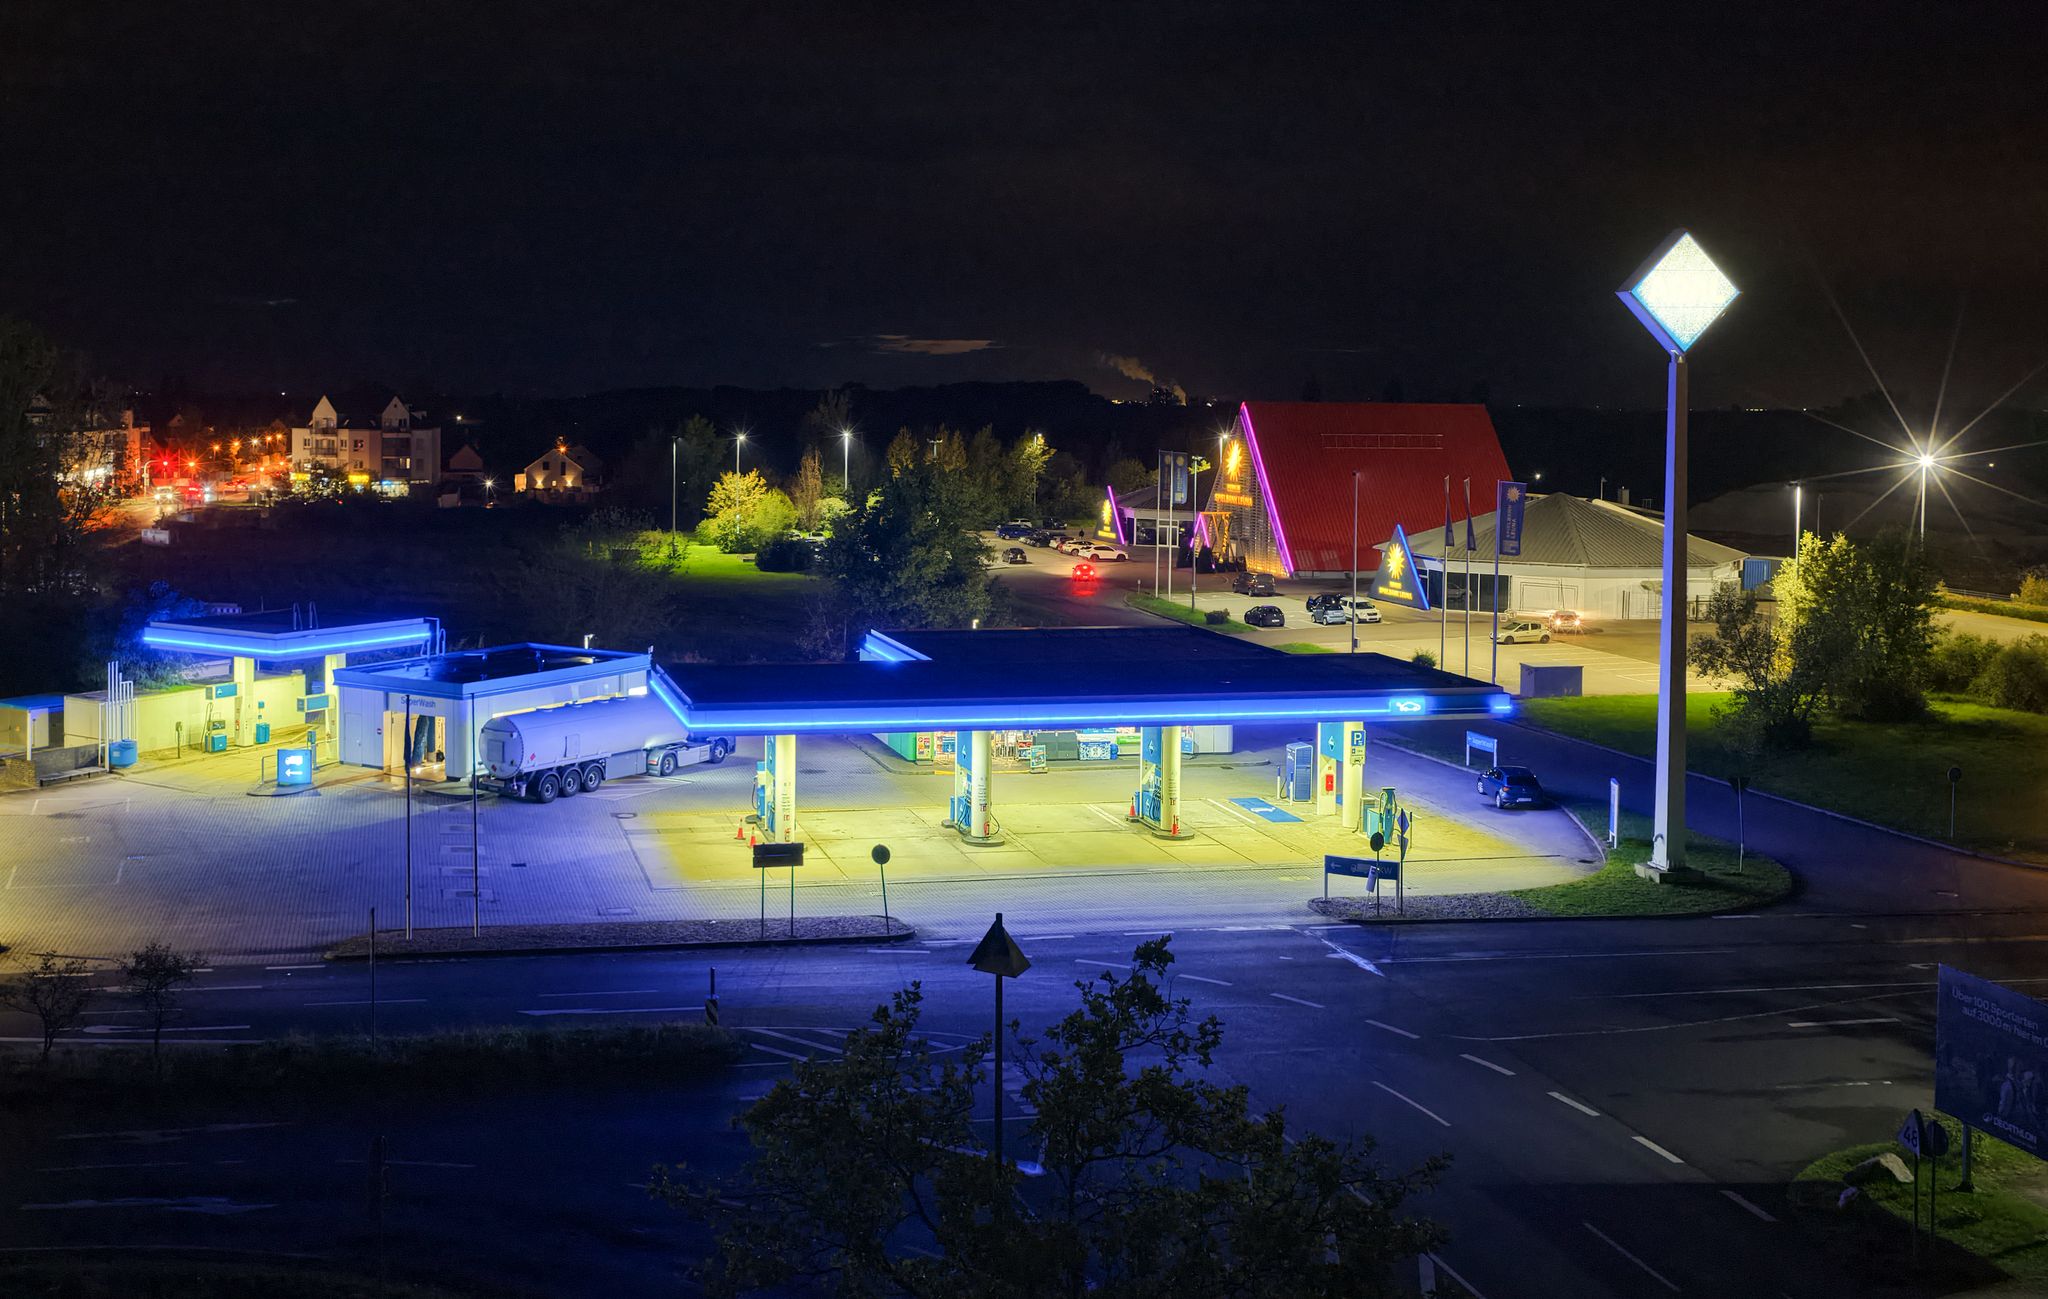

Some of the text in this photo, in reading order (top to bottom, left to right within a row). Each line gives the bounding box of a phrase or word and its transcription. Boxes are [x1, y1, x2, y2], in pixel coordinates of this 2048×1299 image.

[401, 696, 436, 708] SperWash
[1354, 732, 1362, 745] P
[1974, 996, 1989, 1010] 100
[1903, 1126, 1918, 1148] 48
